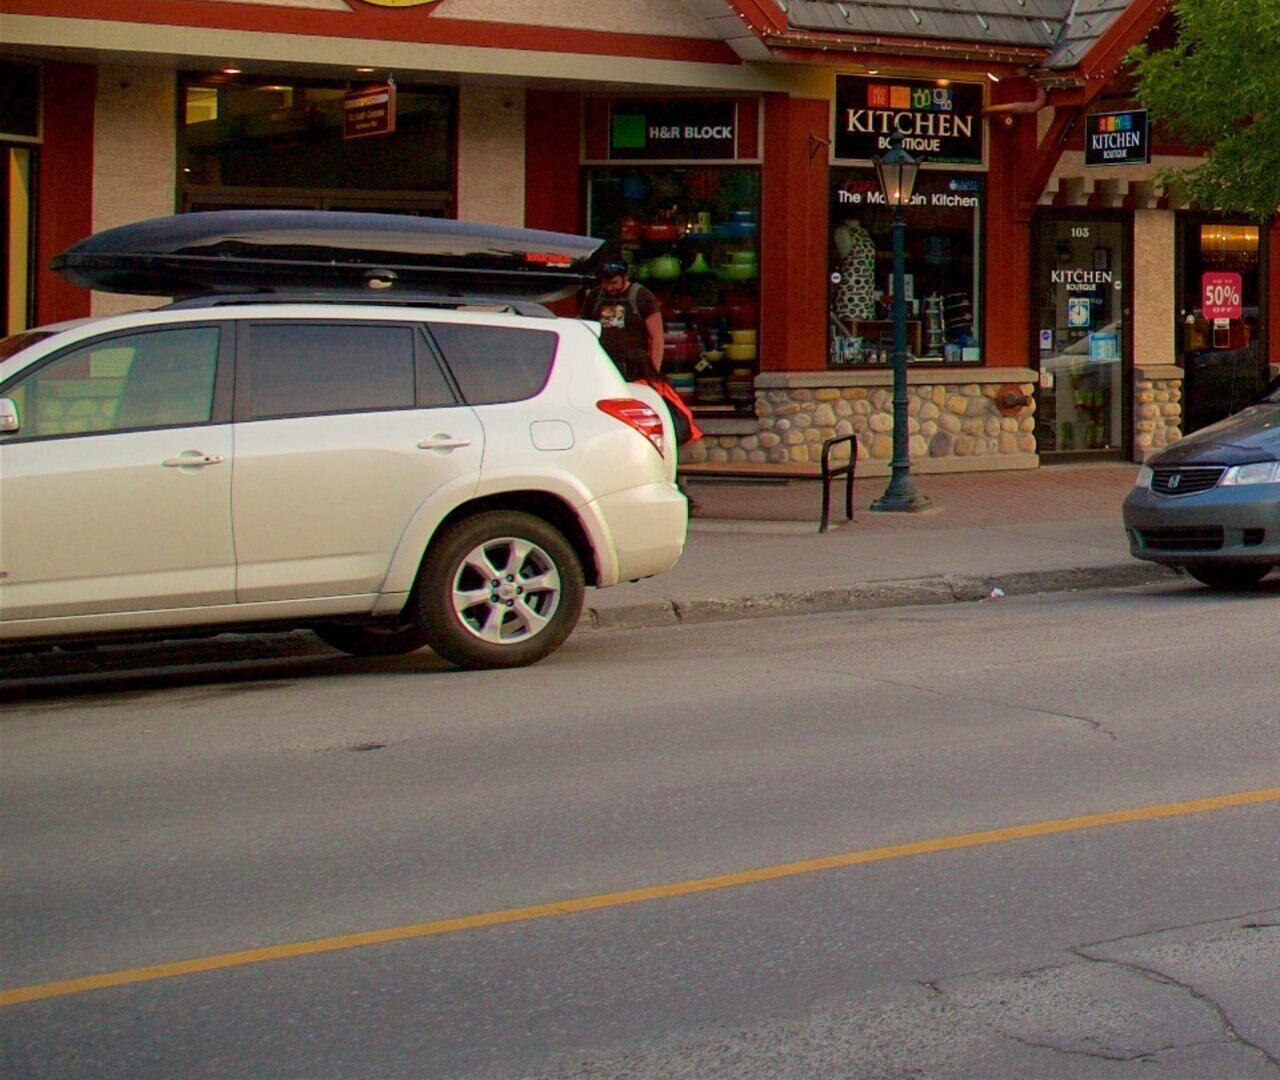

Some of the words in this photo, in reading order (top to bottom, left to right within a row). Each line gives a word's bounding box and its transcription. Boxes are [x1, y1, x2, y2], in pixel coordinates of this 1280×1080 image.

[847, 108, 973, 138] KITCHEN
[649, 126, 680, 139] H&R
[684, 126, 733, 139] BLOCK
[1092, 131, 1140, 150] KITCHEN
[838, 190, 861, 204] The
[931, 193, 979, 208] Kitchen
[1070, 227, 1090, 238] 103
[1051, 270, 1112, 283] KITCHEN
[1205, 285, 1240, 306] 50%
